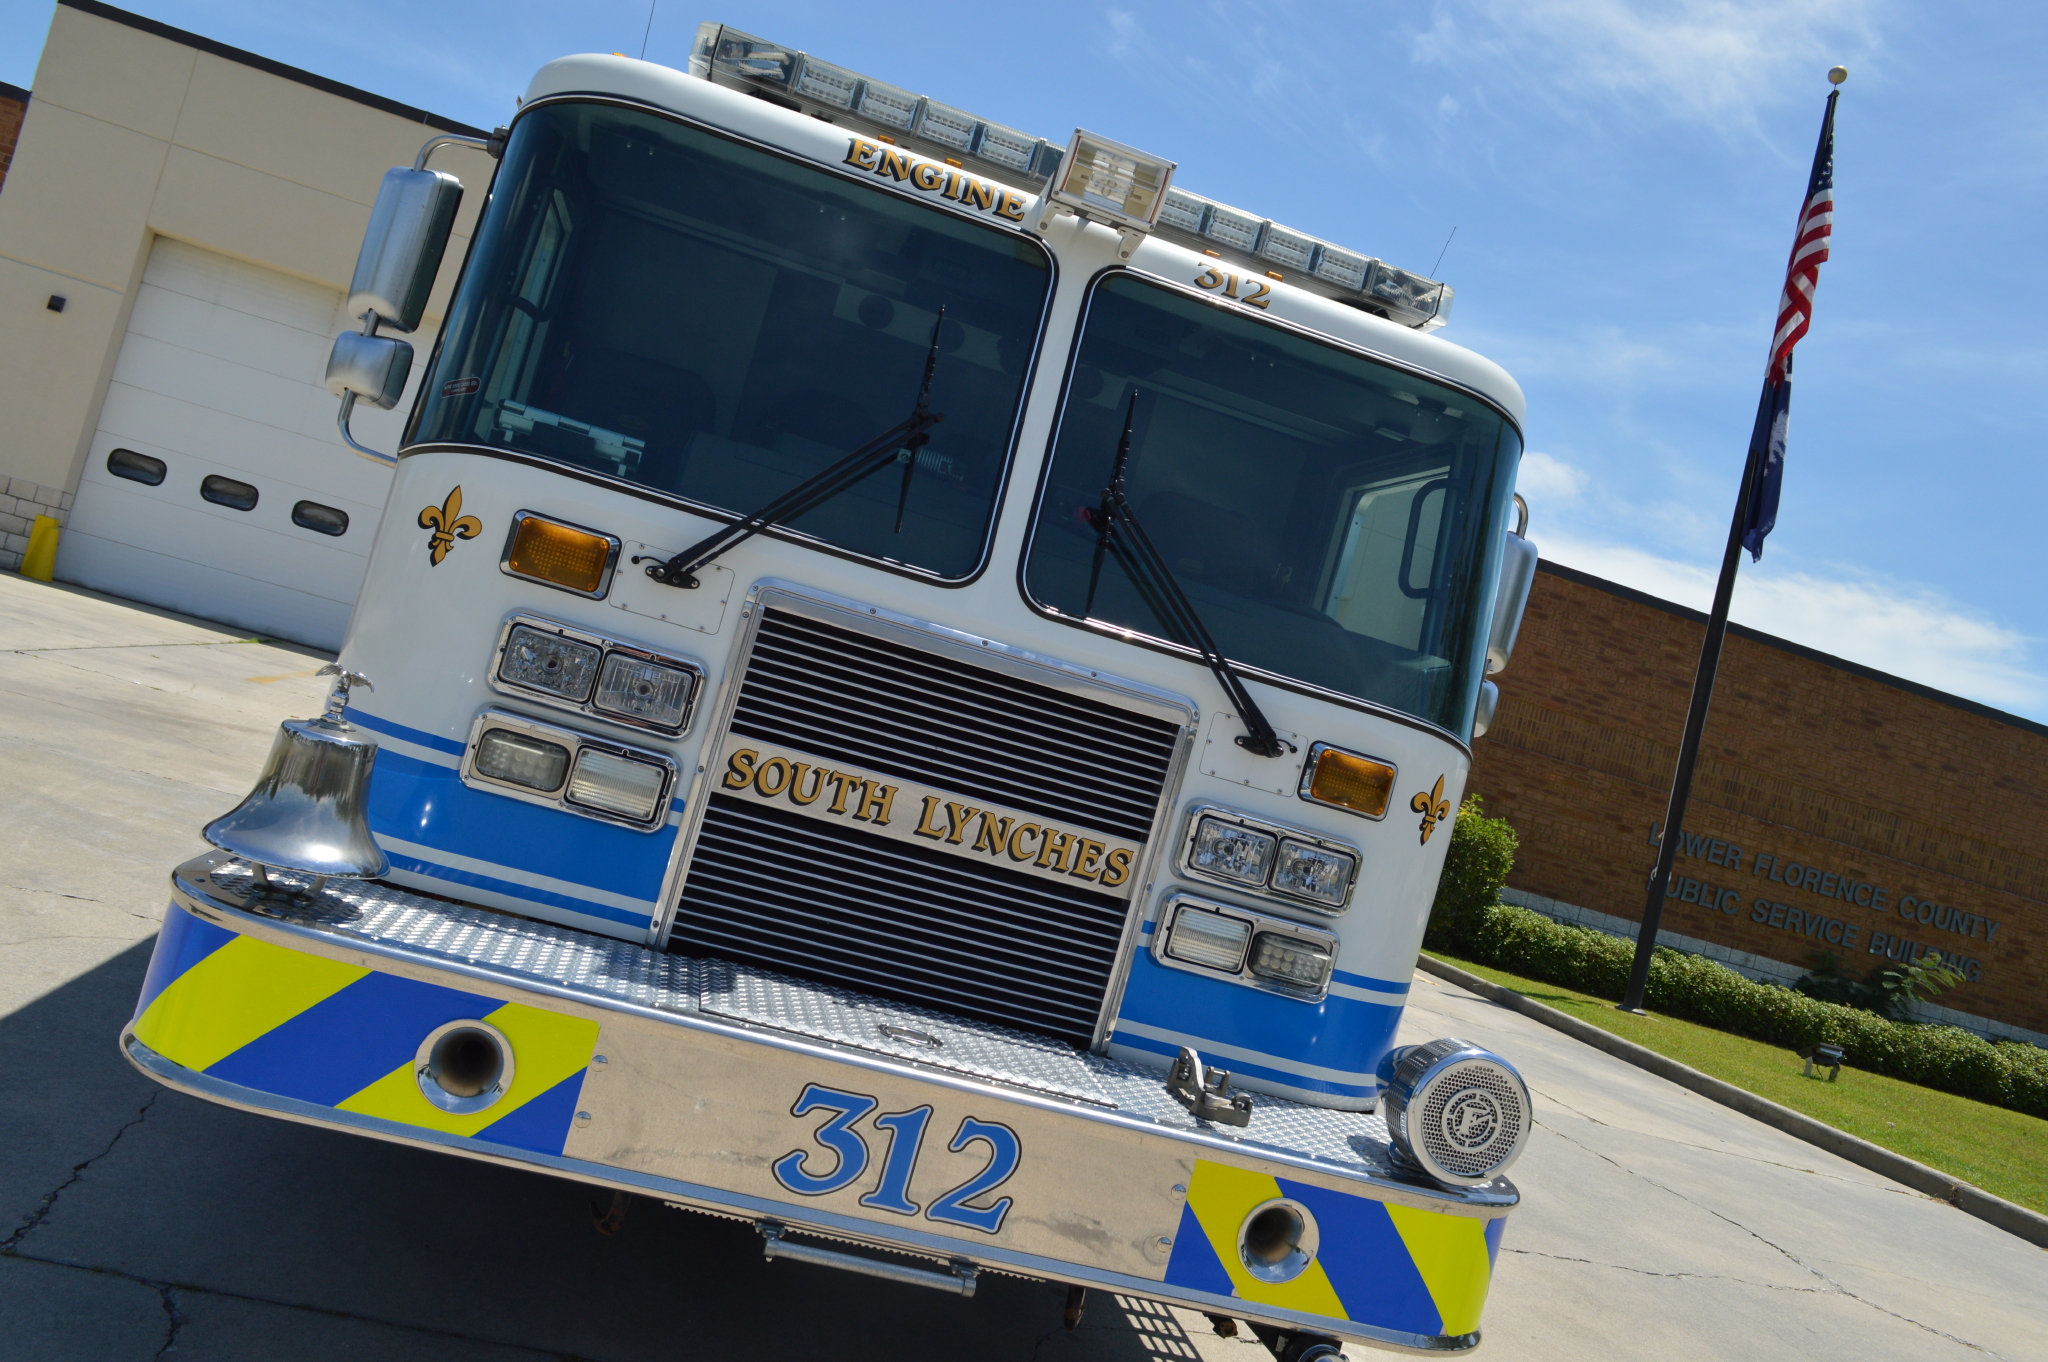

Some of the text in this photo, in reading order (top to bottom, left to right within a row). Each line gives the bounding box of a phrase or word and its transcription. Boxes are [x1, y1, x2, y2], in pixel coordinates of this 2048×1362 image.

[842, 137, 1027, 222] ENGINE
[1194, 261, 1271, 310] 312
[721, 748, 1134, 887] SOUTH LYNCHES
[1646, 870, 1741, 915] UBLIC
[1750, 898, 1860, 949] SERVICE
[1753, 853, 1889, 912] FLORENCE
[1899, 896, 2001, 943] COUNTY
[771, 1082, 1022, 1234] 312
